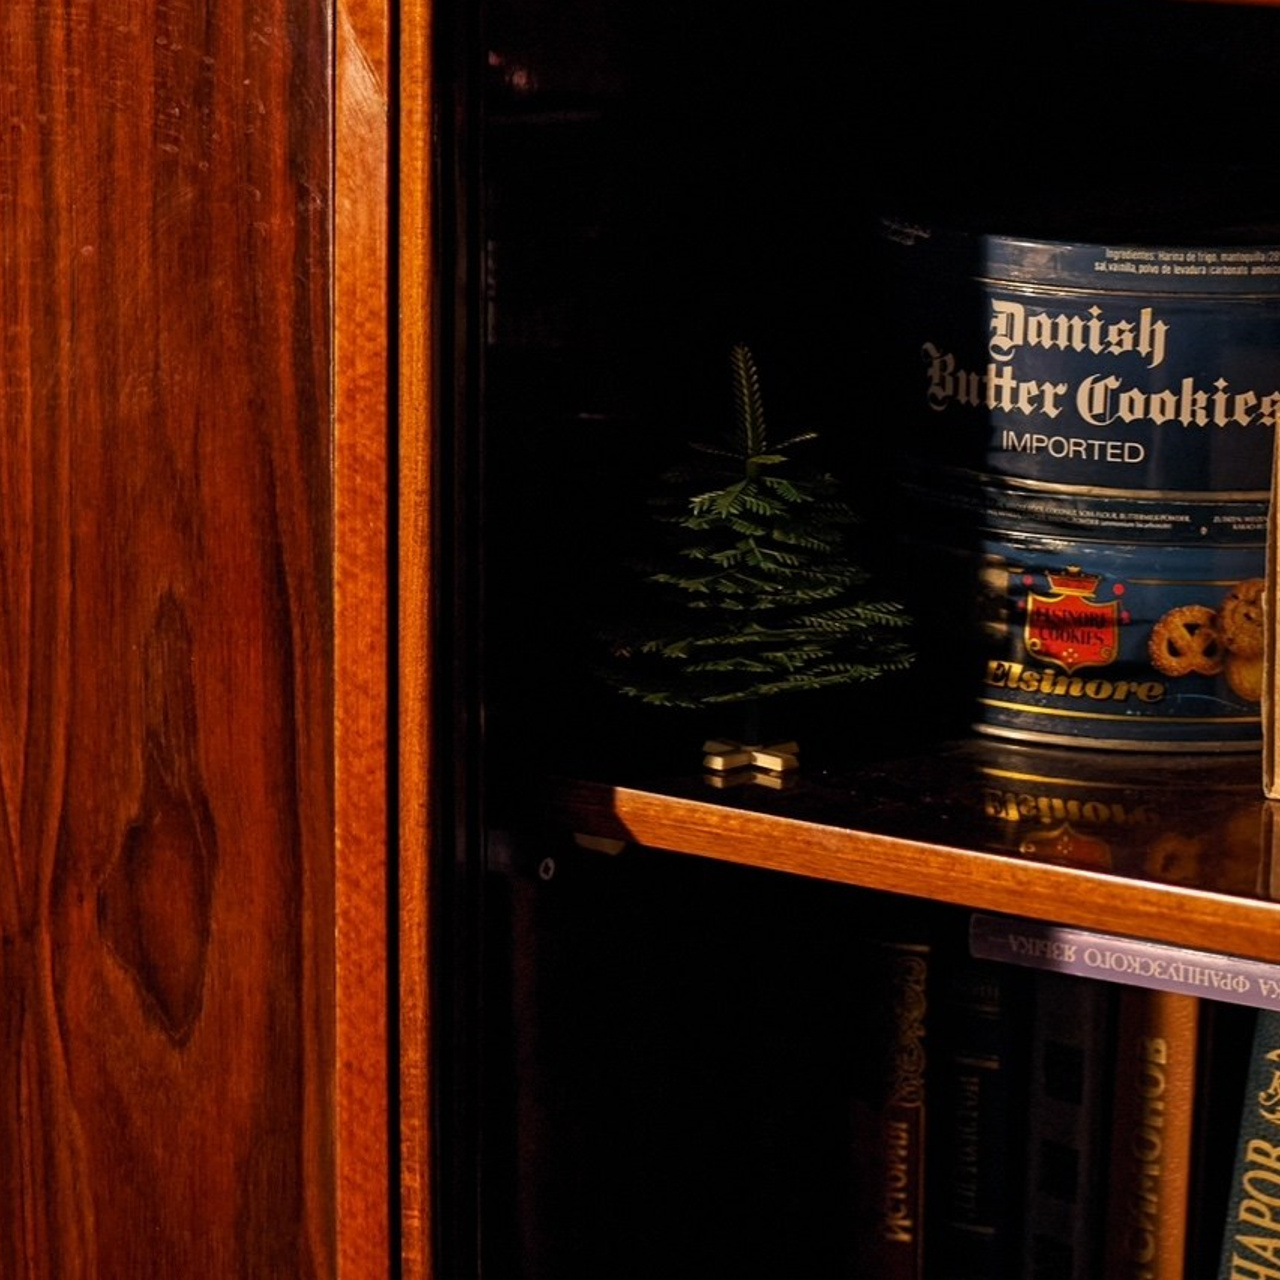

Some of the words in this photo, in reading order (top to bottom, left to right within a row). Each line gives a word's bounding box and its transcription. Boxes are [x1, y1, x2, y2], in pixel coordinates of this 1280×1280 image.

[989, 297, 1170, 370] Danish
[921, 340, 1069, 419] Butter
[1002, 429, 1146, 464] IMPORTED
[984, 658, 1168, 704] Elsinore
[1008, 933, 1077, 963] ЯЗЫКА
[1083, 947, 1250, 993] ФРАНЦУЗСКОГО
